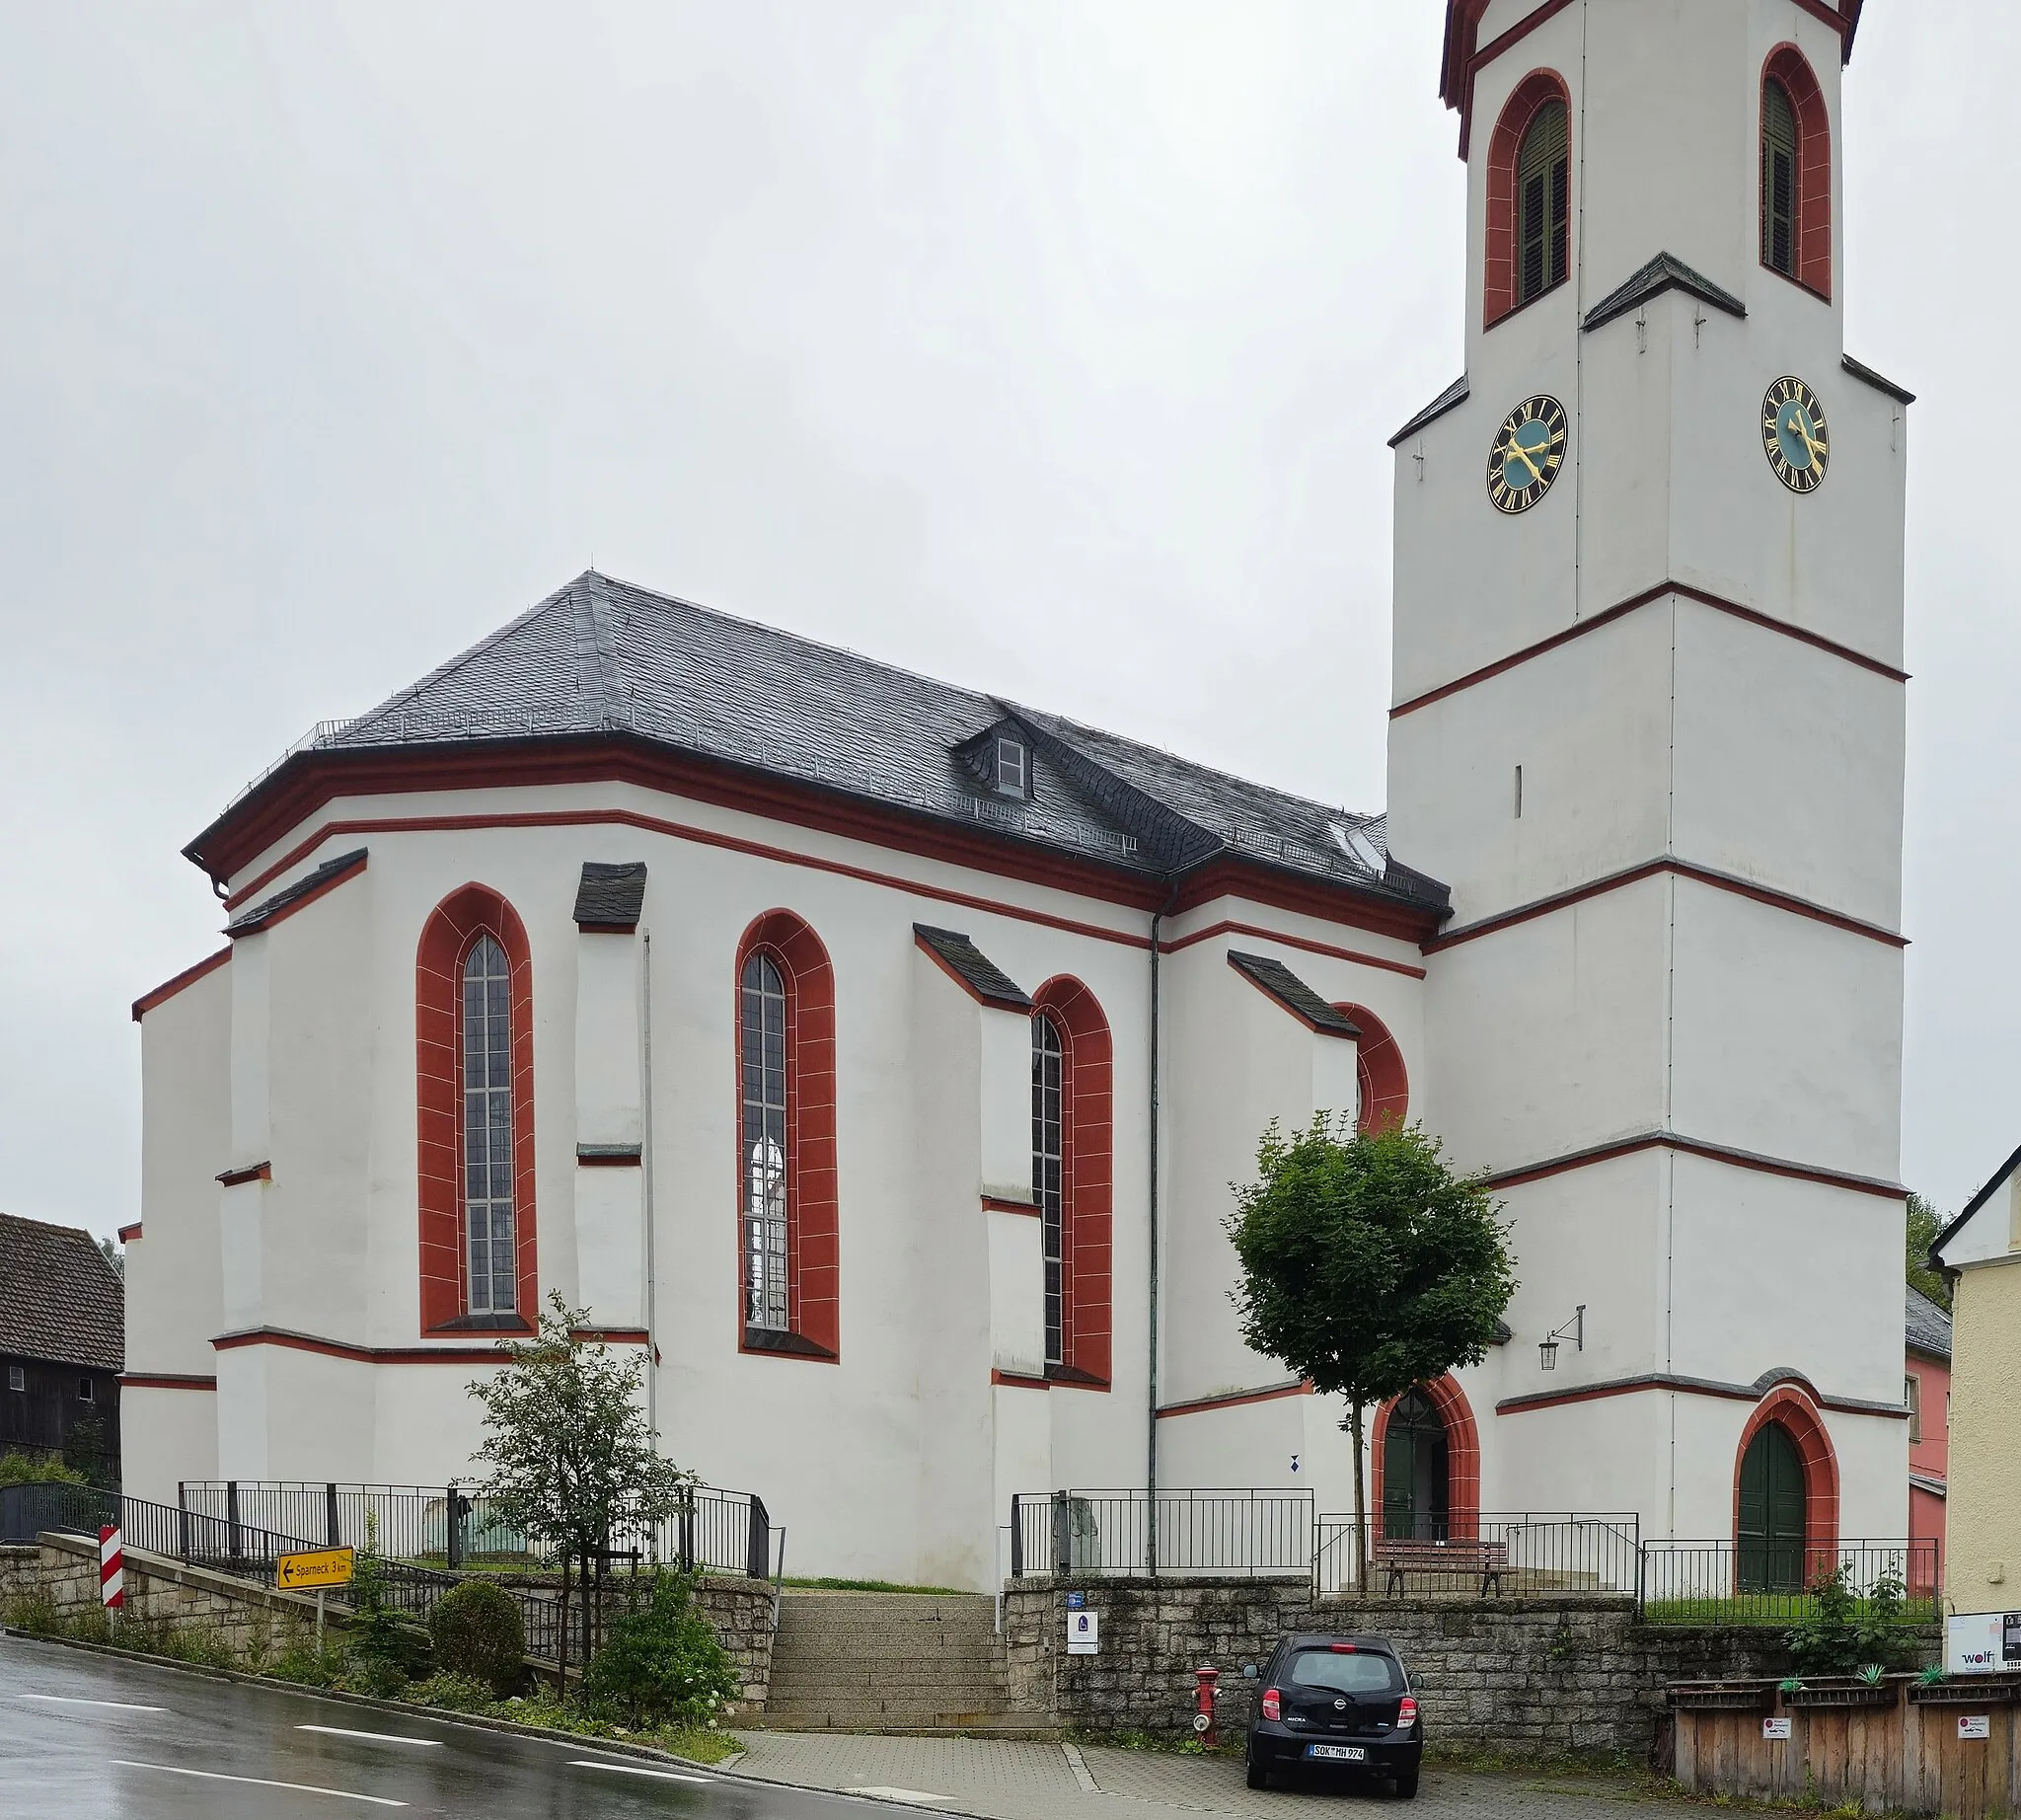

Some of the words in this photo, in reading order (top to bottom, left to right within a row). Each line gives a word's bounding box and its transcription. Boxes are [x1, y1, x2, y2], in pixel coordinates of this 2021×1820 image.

[296, 1562, 330, 1578] Sparneck
[332, 1560, 337, 1572] 3
[337, 1563, 346, 1572] km
[1962, 1651, 1994, 1664] wolf
[1314, 1746, 1330, 1756] SOK
[1335, 1747, 1347, 1758] MH
[1348, 1749, 1363, 1758] 974
